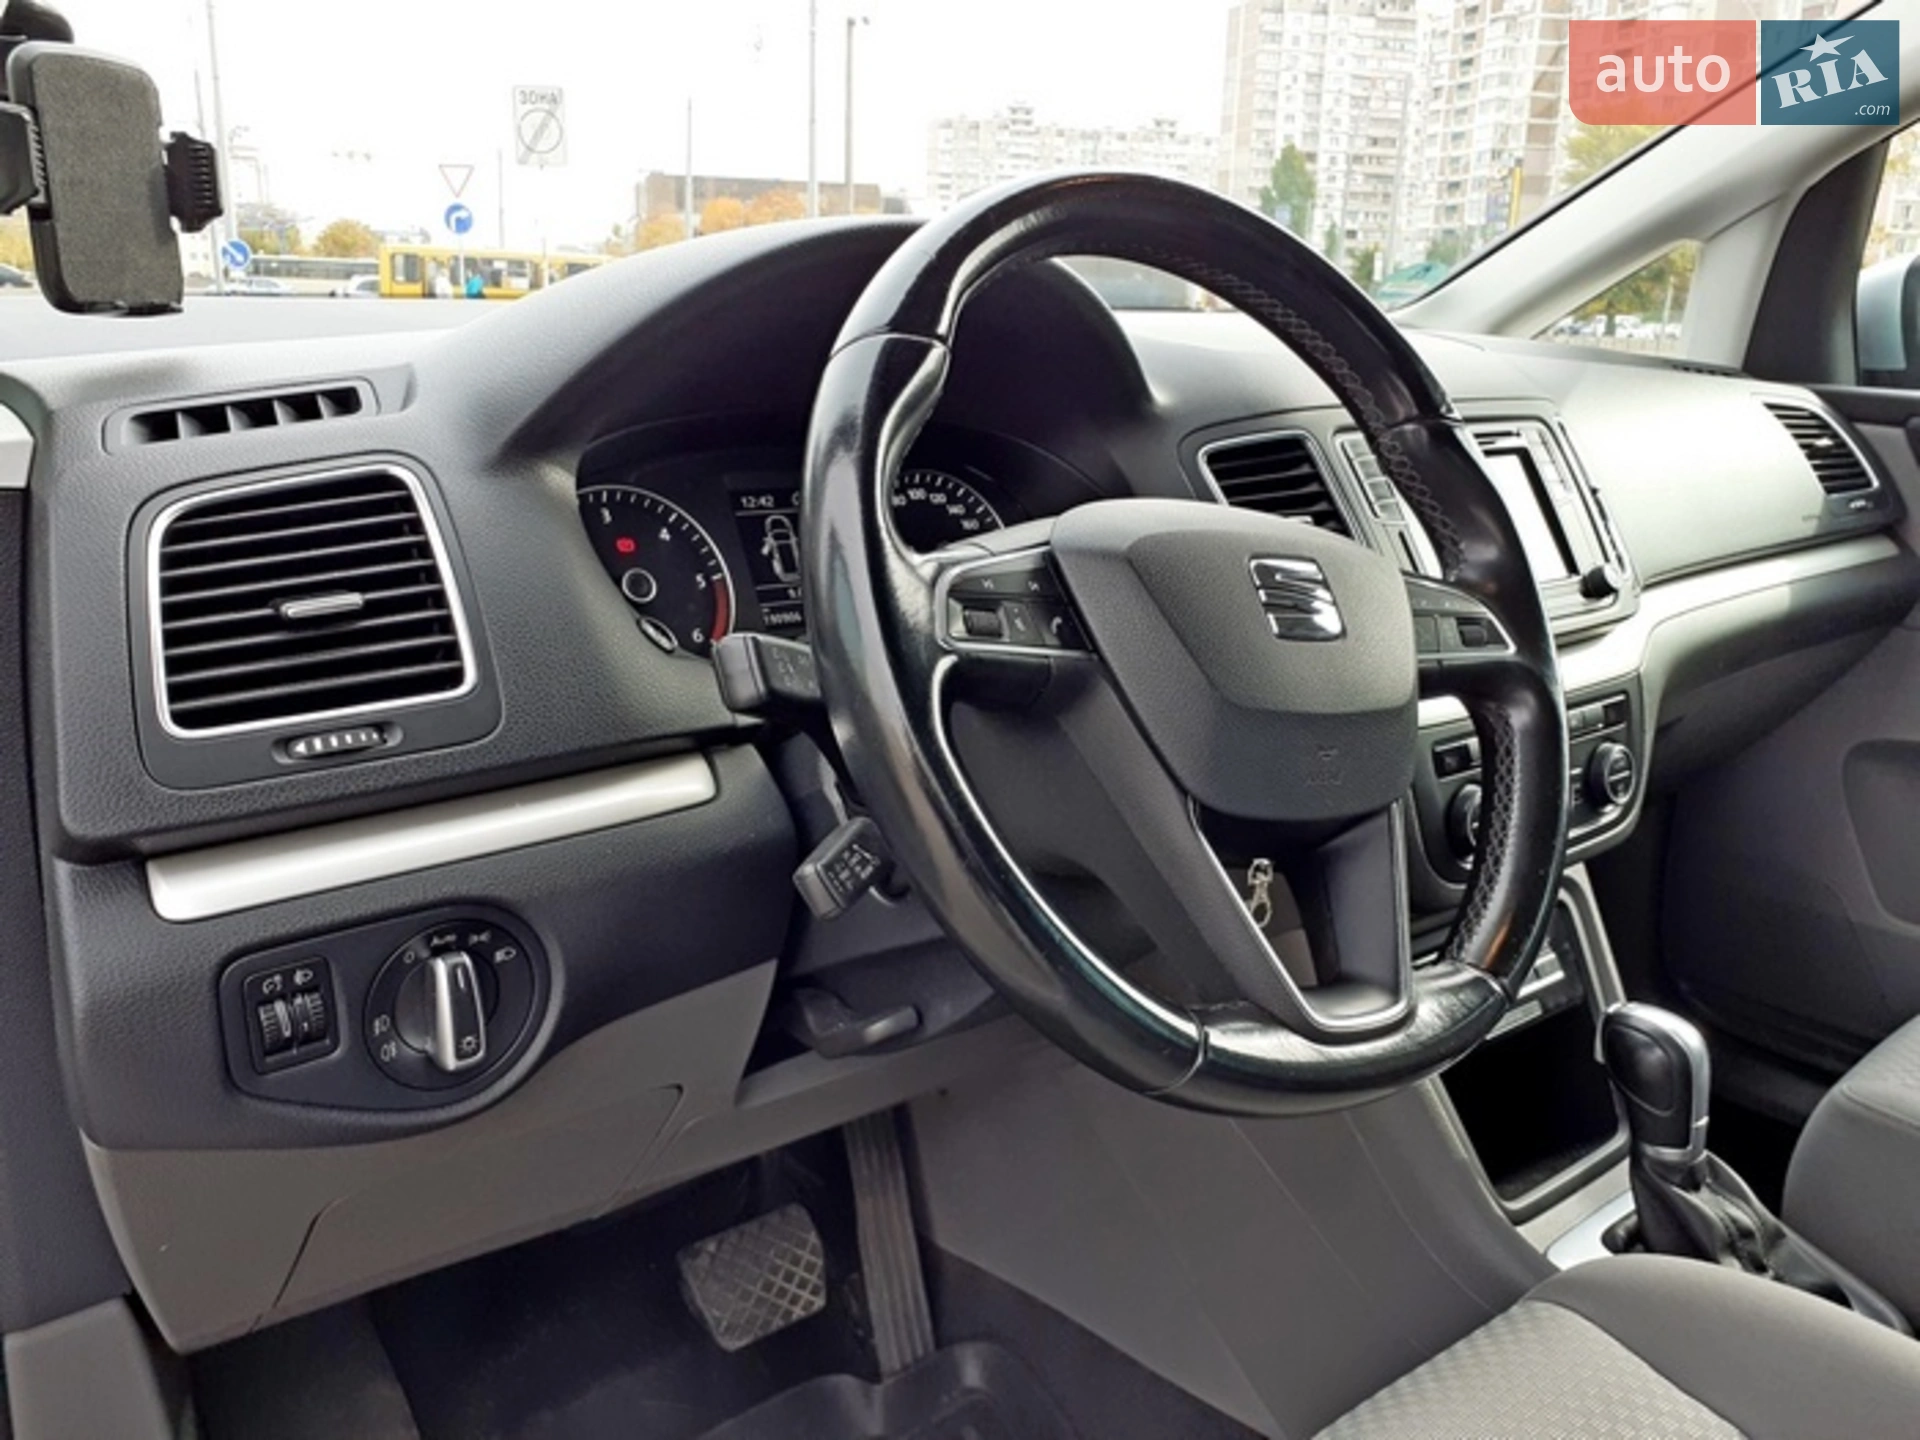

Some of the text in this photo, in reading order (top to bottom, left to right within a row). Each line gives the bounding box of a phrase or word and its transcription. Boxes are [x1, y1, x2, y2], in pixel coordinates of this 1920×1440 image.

[519, 90, 558, 105] ЗОНА
[907, 487, 927, 500] 100
[600, 507, 706, 643] 3 4 5 6
